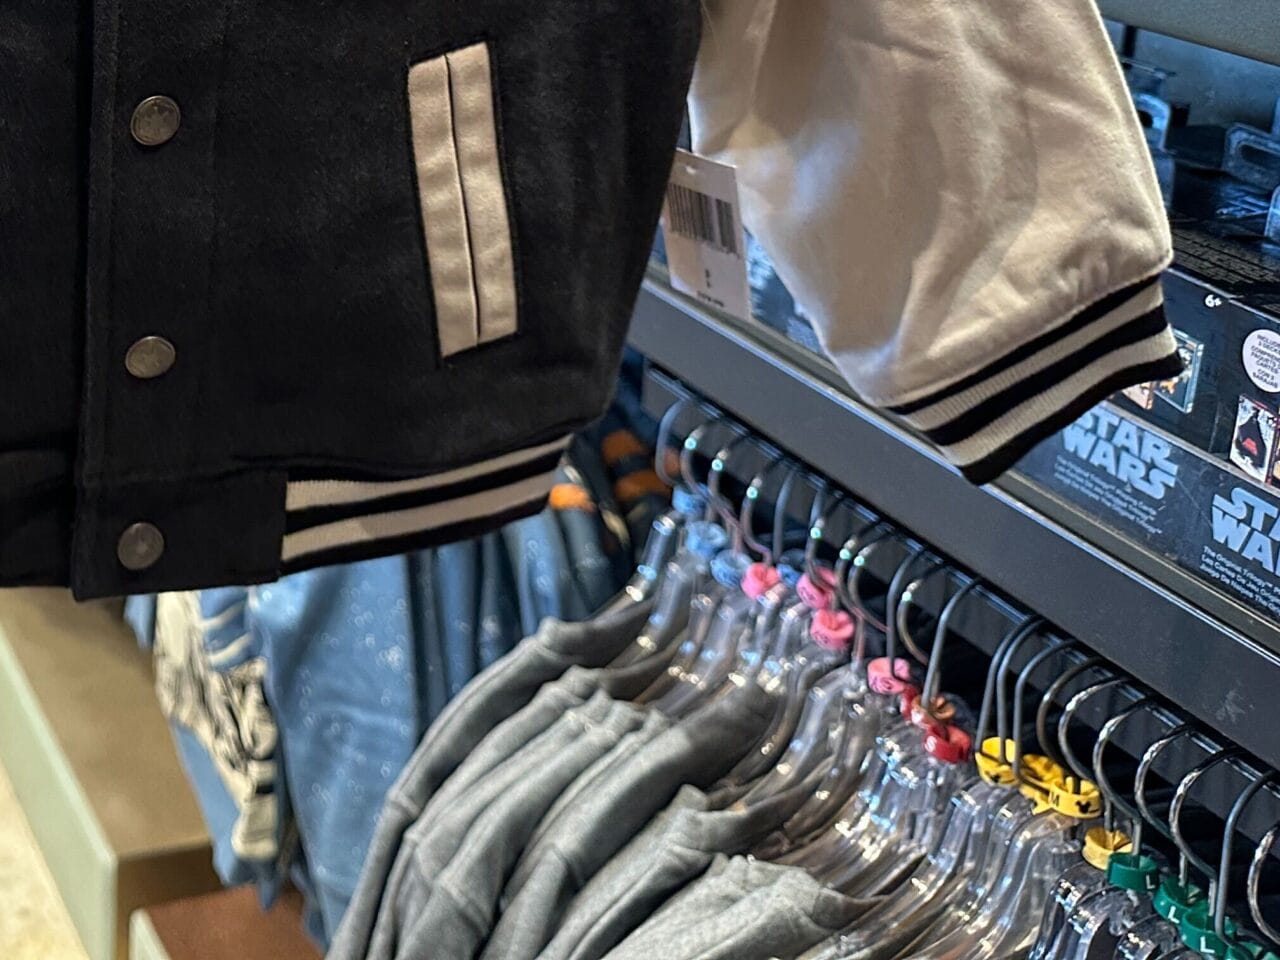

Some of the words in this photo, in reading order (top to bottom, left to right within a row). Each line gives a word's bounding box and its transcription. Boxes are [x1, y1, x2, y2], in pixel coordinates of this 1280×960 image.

[1070, 403, 1179, 476] STAR
[1062, 426, 1177, 500] WARS
[1212, 505, 1280, 577] WA
[1203, 545, 1216, 558] The
[1220, 574, 1230, 585] De
[1236, 574, 1246, 585] De
[1246, 581, 1260, 592] Jeu
[1146, 874, 1156, 890] L
[1167, 905, 1180, 924] L
[1200, 936, 1216, 954] L
